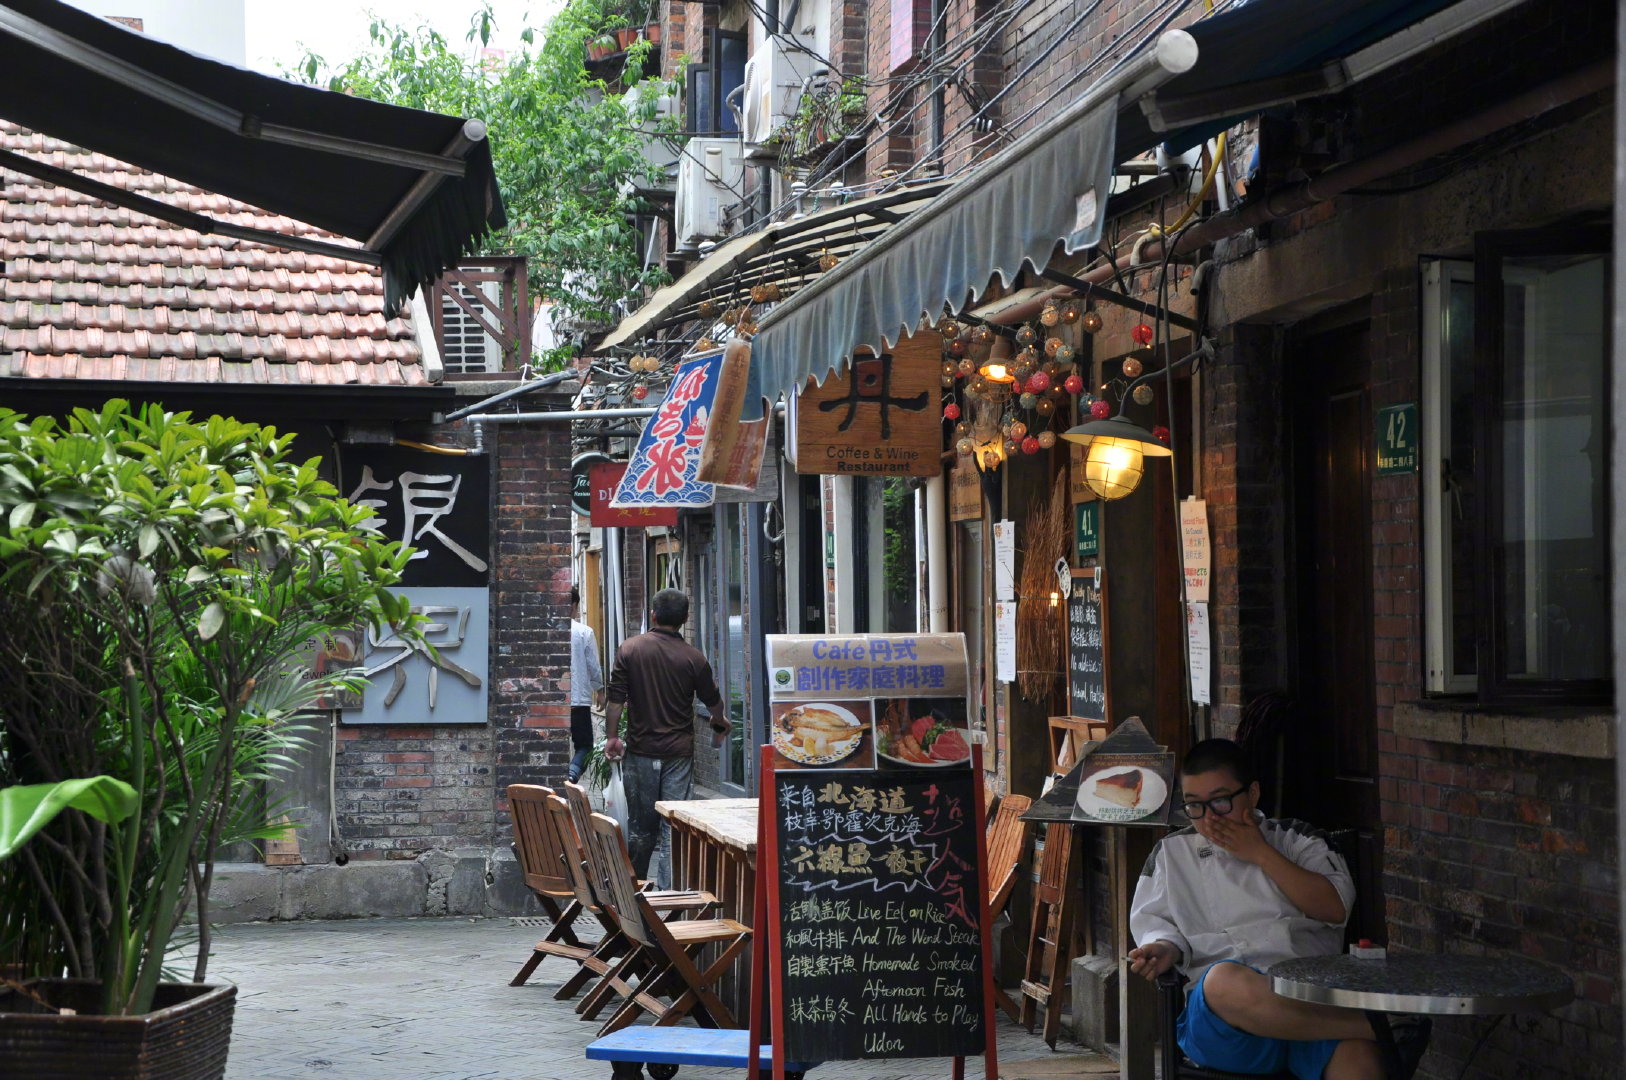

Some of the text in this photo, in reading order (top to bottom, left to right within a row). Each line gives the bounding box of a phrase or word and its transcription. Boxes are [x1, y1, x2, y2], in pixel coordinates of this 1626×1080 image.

[1386, 411, 1406, 449] 42
[826, 445, 919, 461] Coffee & Wine
[836, 461, 910, 473] Restaurant
[1081, 509, 1093, 536] 41
[812, 640, 866, 661] Café
[797, 664, 944, 691] 創作家庭料理
[780, 781, 915, 814] 来自北海道
[858, 900, 881, 919] Live
[886, 901, 908, 922] Eel
[909, 906, 923, 919] on
[925, 902, 948, 924] Rice
[851, 926, 880, 946] And
[885, 926, 906, 944] The
[911, 926, 942, 946] Wind
[945, 924, 981, 947] Steak
[862, 951, 920, 972] Homemade
[926, 950, 977, 971] Smoked
[861, 977, 966, 1004] Afternoon Fish
[863, 1004, 887, 1025] All
[892, 1004, 928, 1024] Hands
[933, 1007, 948, 1022] to
[951, 1003, 979, 1032] Play
[864, 1031, 904, 1053] Udon
